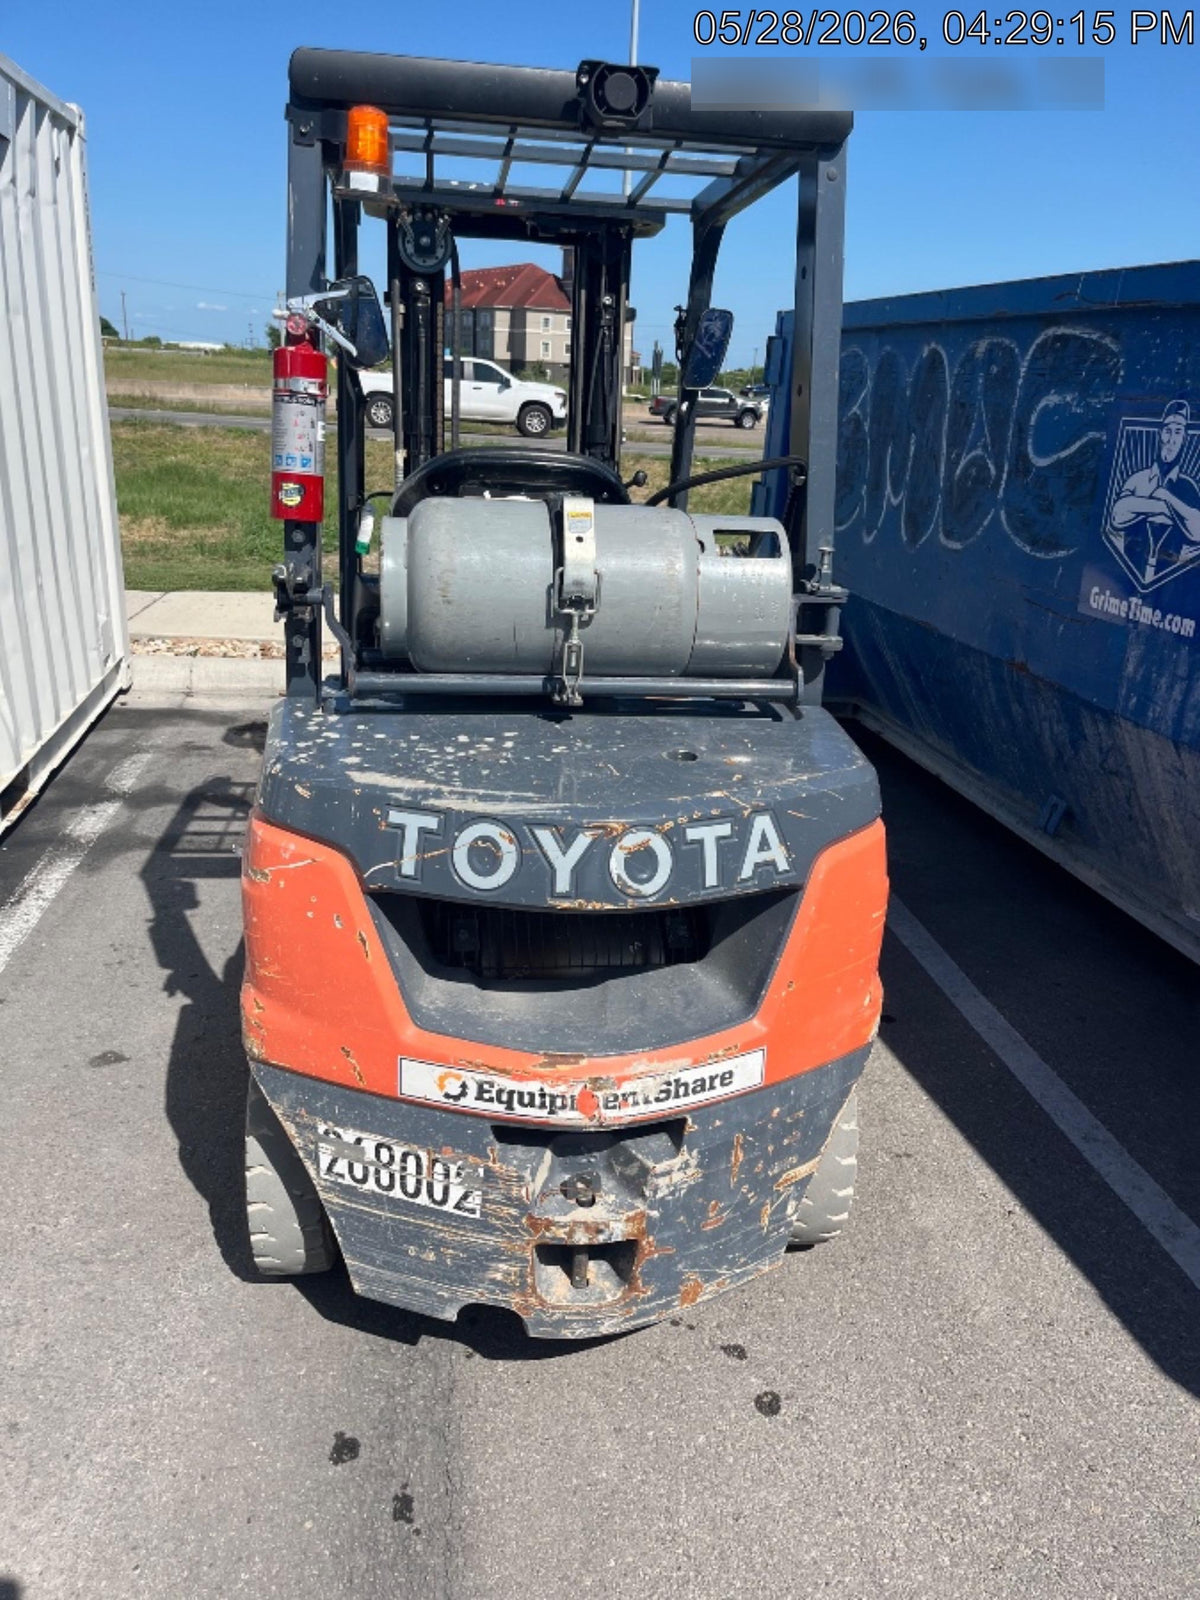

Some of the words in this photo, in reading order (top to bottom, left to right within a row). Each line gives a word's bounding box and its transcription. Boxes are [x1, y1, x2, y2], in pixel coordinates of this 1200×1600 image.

[1089, 586, 1195, 637] GrimeTime.com
[388, 810, 790, 895] TOYOTA
[474, 1069, 734, 1115] EquipenShare
